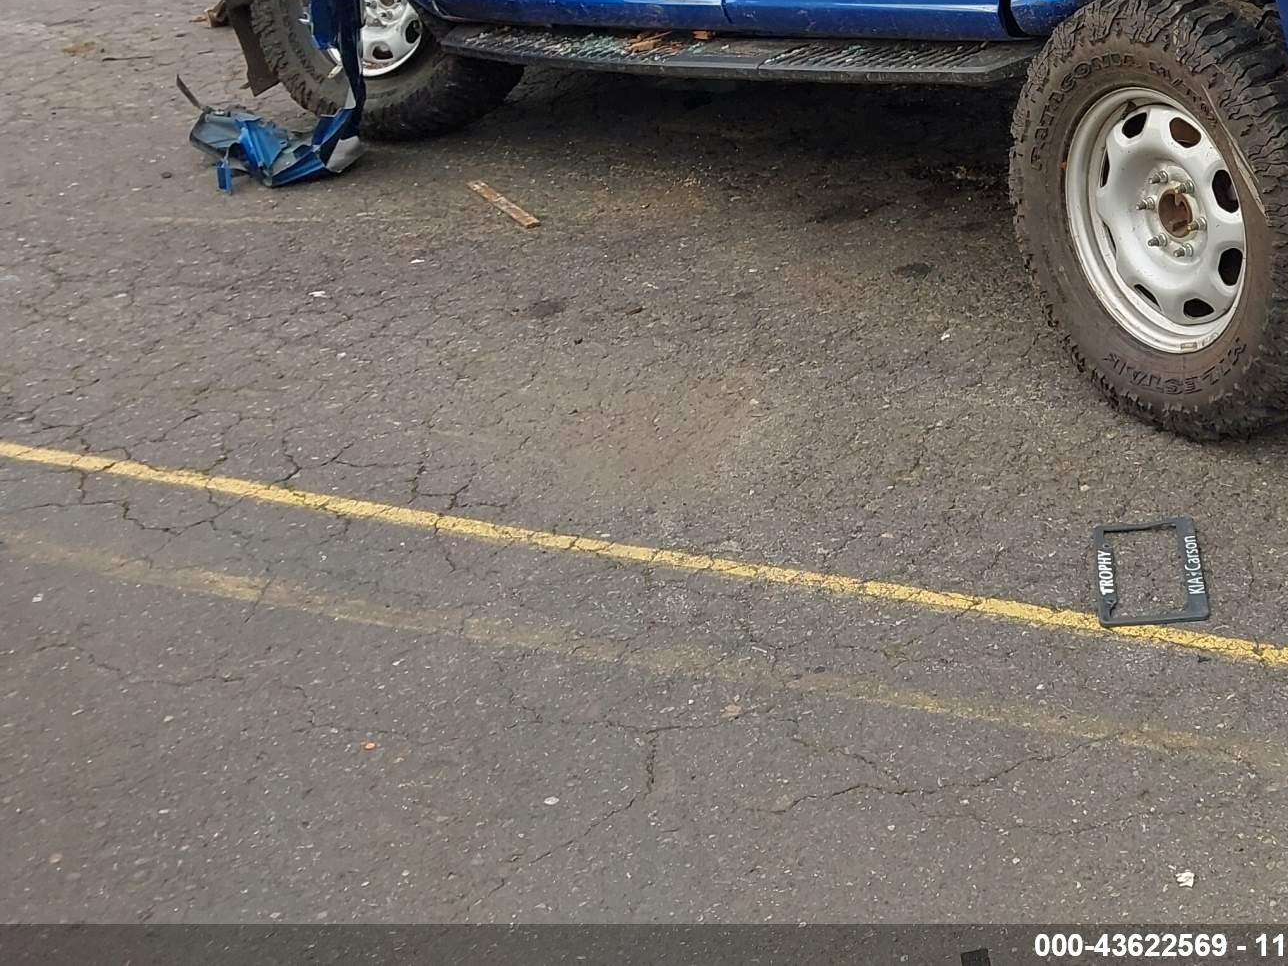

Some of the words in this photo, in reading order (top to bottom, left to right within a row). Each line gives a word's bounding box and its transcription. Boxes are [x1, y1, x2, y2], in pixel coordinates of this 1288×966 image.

[1183, 535, 1202, 571] Carson
[1097, 550, 1115, 596] TROPHY
[1186, 577, 1206, 595] KIA
